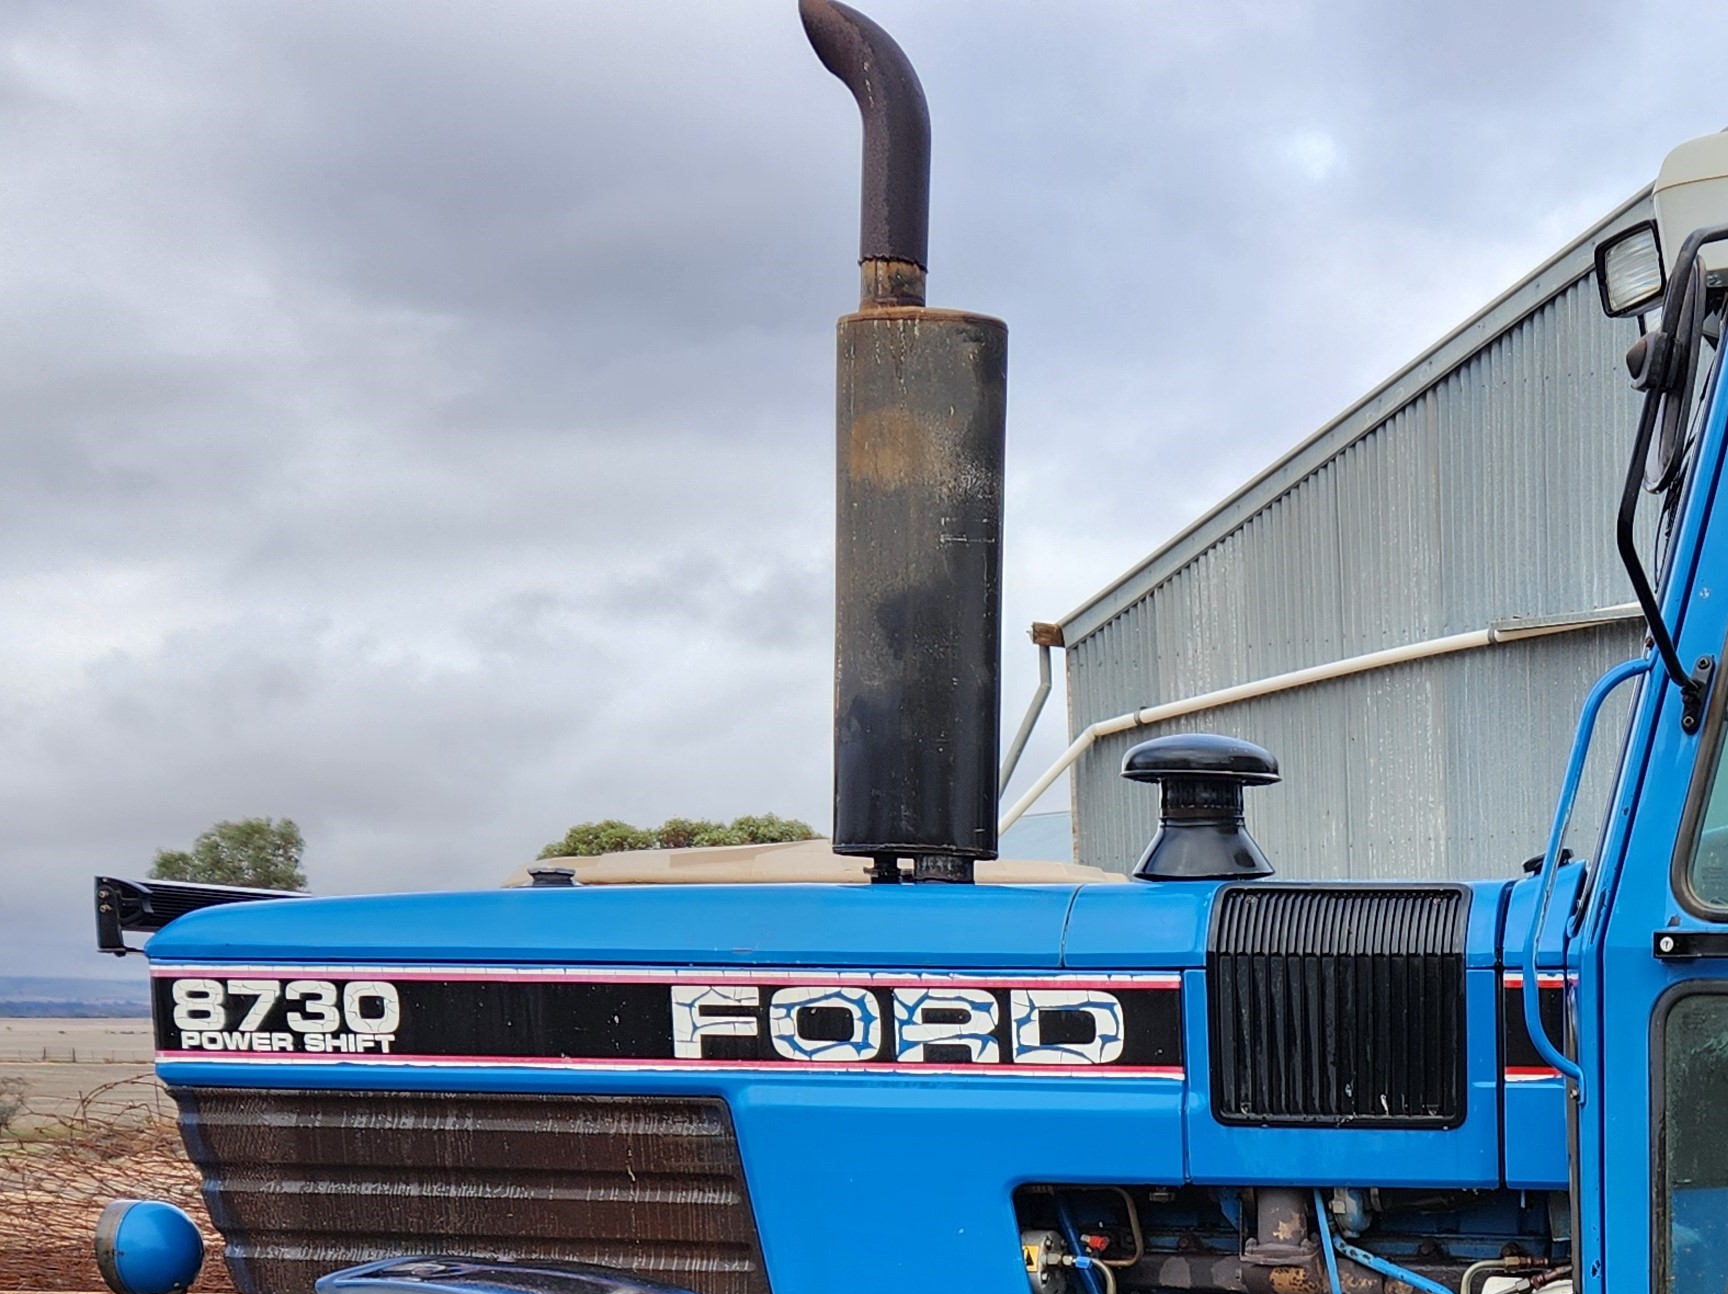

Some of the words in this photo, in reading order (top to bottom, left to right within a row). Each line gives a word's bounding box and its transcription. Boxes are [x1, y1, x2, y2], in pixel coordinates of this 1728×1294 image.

[171, 978, 401, 1034] 8730
[671, 985, 1125, 1065] FORD
[181, 1031, 294, 1053] POWER
[304, 1032, 396, 1053] SHIFT
